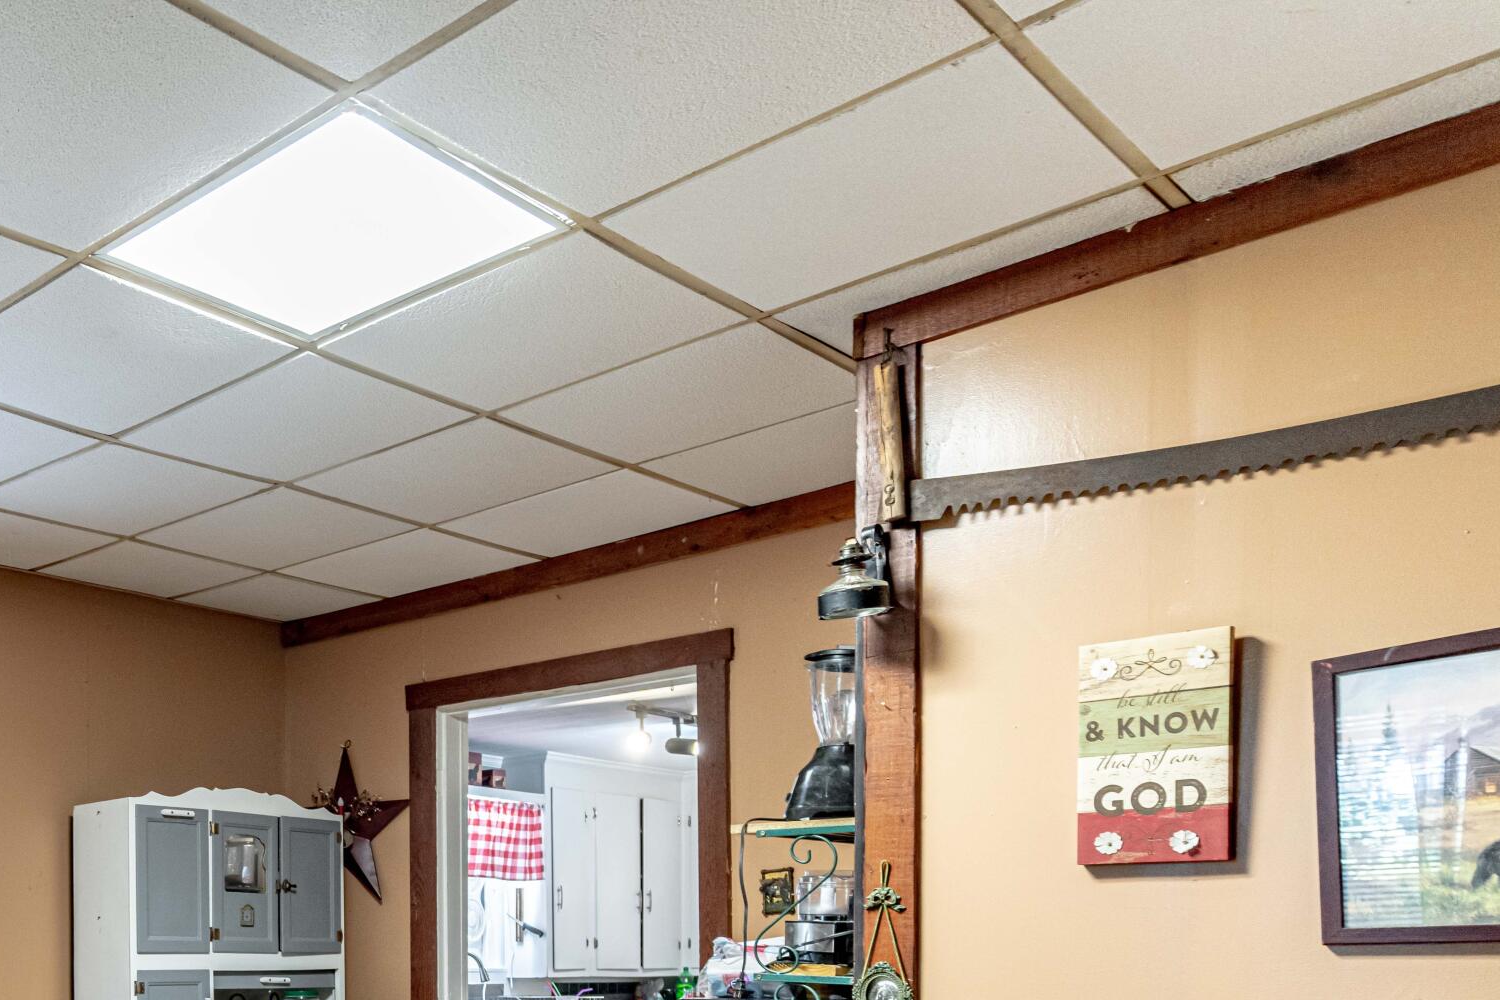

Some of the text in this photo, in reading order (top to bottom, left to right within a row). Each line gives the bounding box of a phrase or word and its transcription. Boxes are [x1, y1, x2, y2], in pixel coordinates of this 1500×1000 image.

[1085, 707, 1220, 742] & KNOW
[1096, 750, 1138, 771] that
[1170, 754, 1203, 765] am
[1093, 778, 1208, 818] GOD
